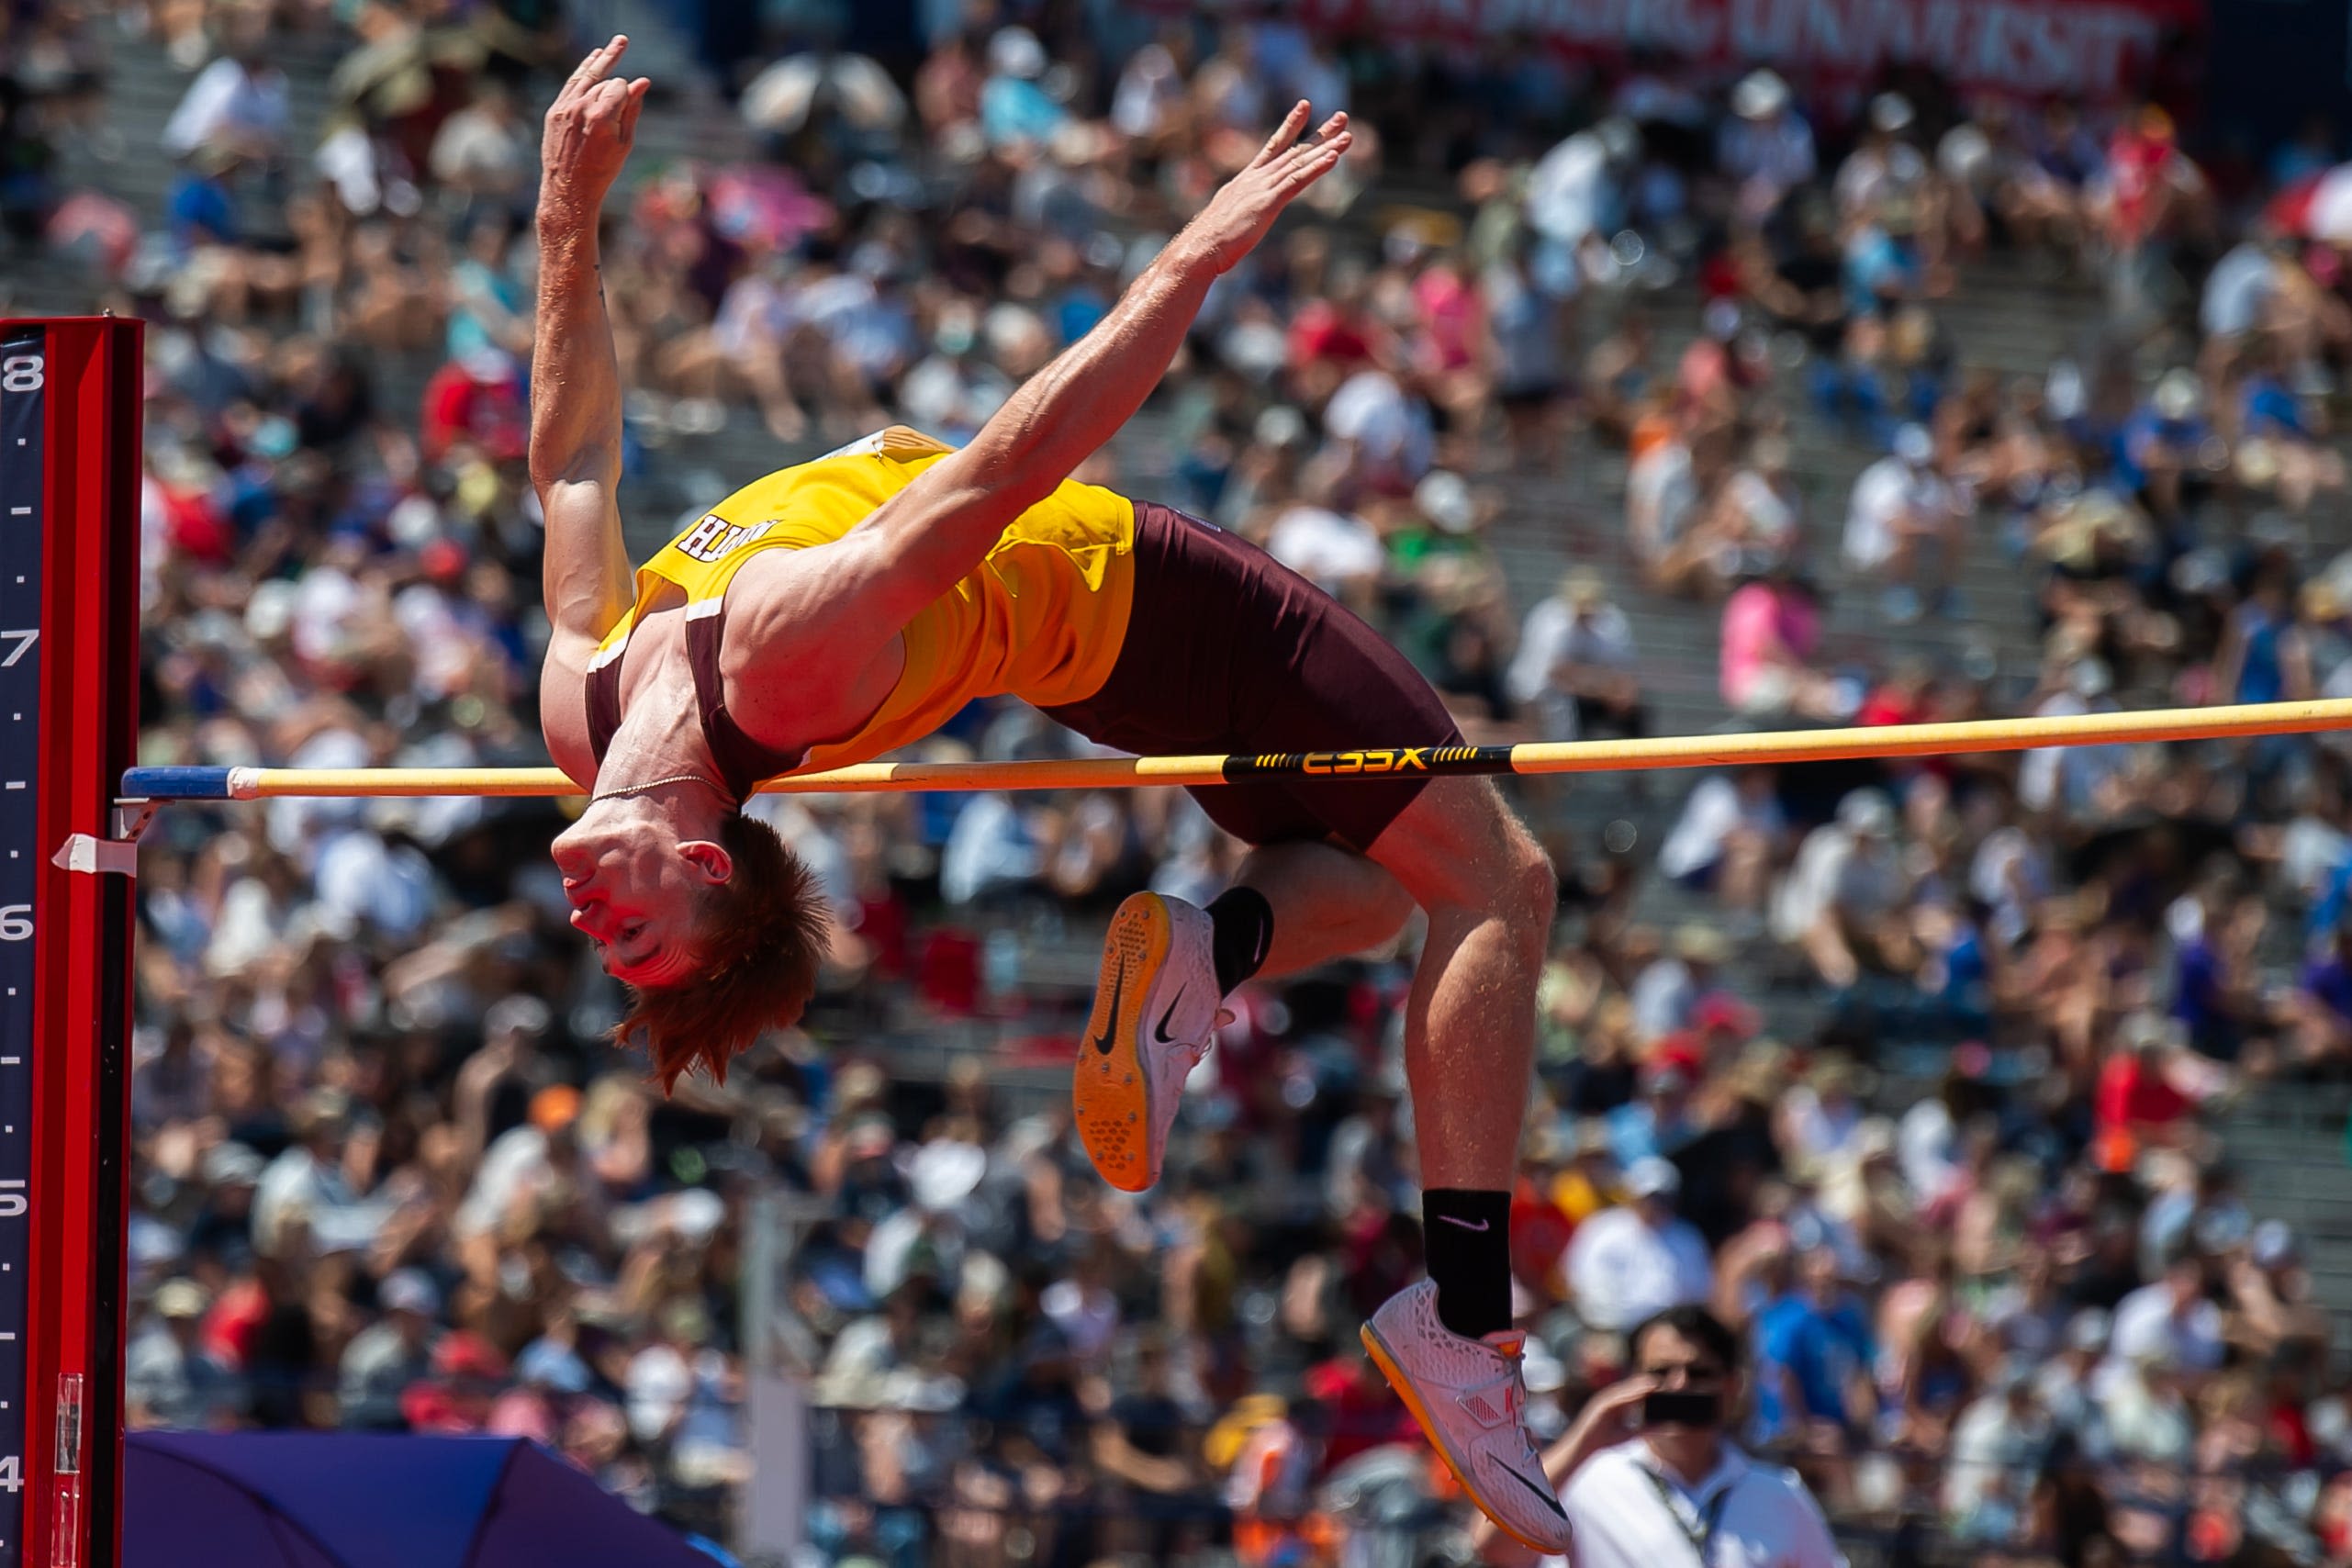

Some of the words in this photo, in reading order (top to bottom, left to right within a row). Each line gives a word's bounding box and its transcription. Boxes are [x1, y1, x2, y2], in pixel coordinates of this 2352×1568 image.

[3, 355, 44, 392] 8
[1, 629, 40, 667] 7
[0, 903, 34, 940] 6
[0, 1180, 28, 1216] 5
[0, 1455, 25, 1493] 4
